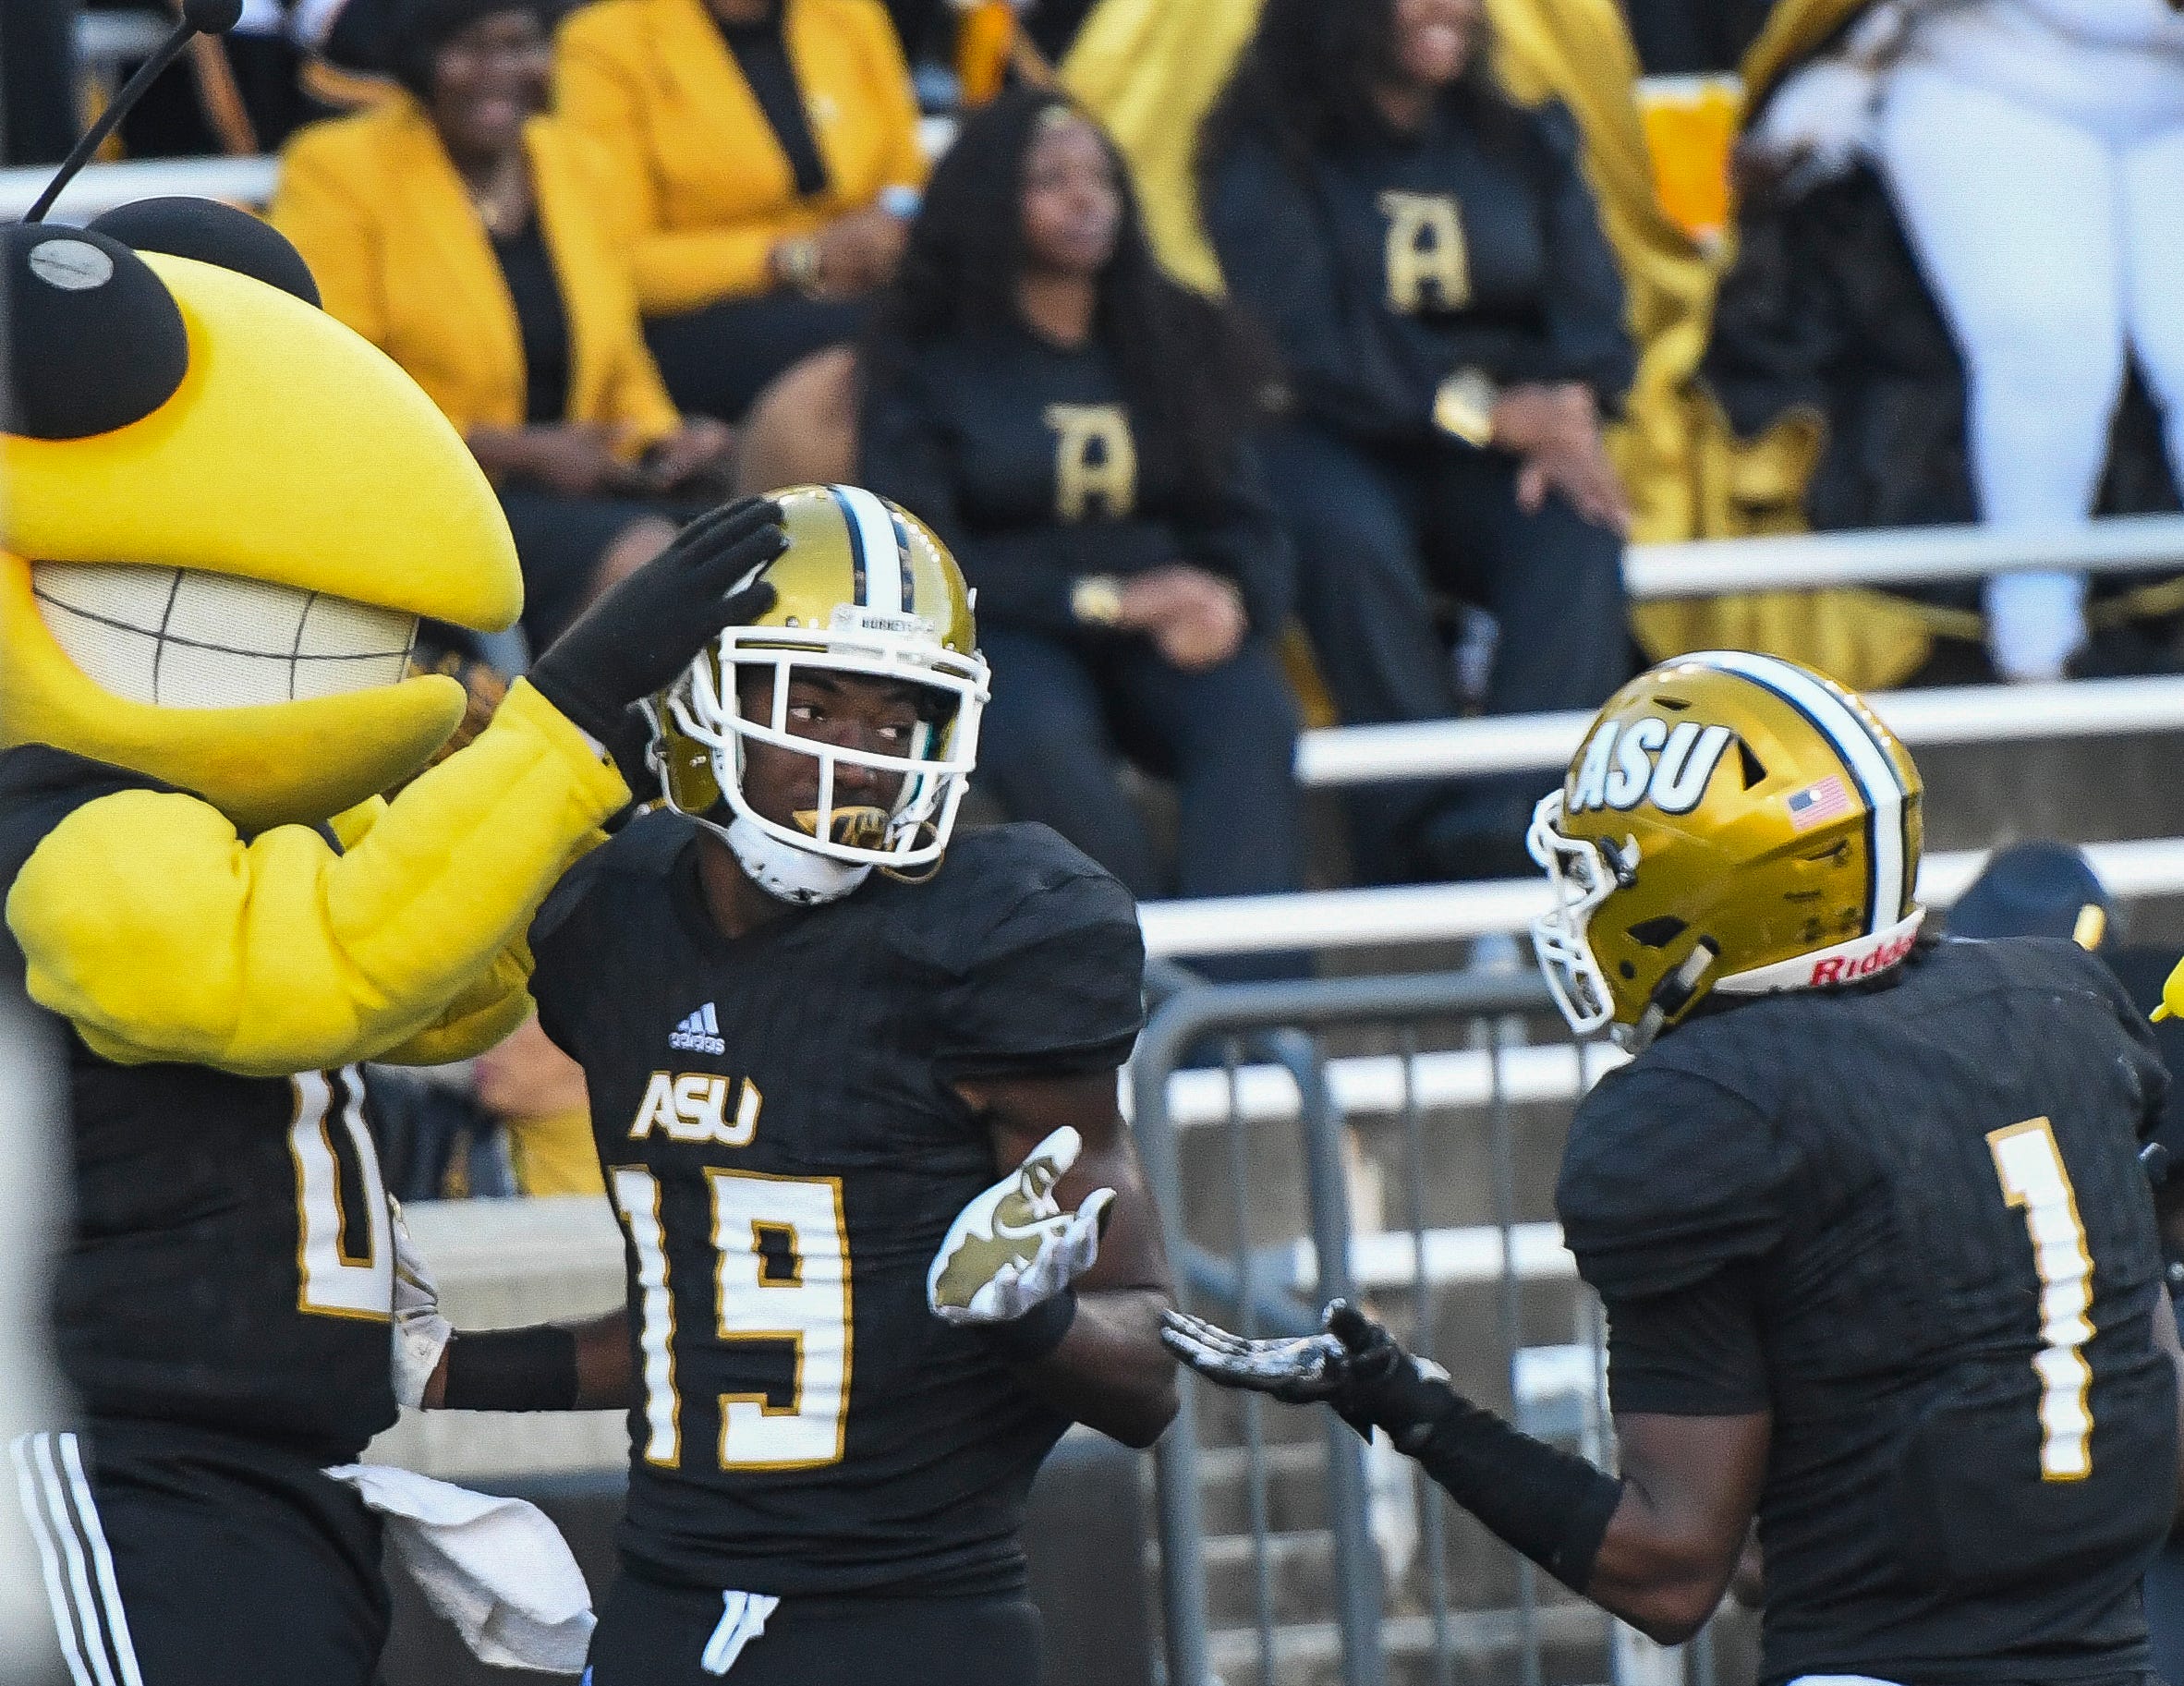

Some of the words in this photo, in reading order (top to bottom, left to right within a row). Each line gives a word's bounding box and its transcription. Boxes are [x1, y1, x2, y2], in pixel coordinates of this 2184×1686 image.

[1568, 717, 1732, 816] ASU
[668, 1031, 726, 1056] adidas
[627, 1070, 764, 1148] ASU
[608, 1162, 855, 1472] 19
[1985, 1116, 2097, 1482] 1
